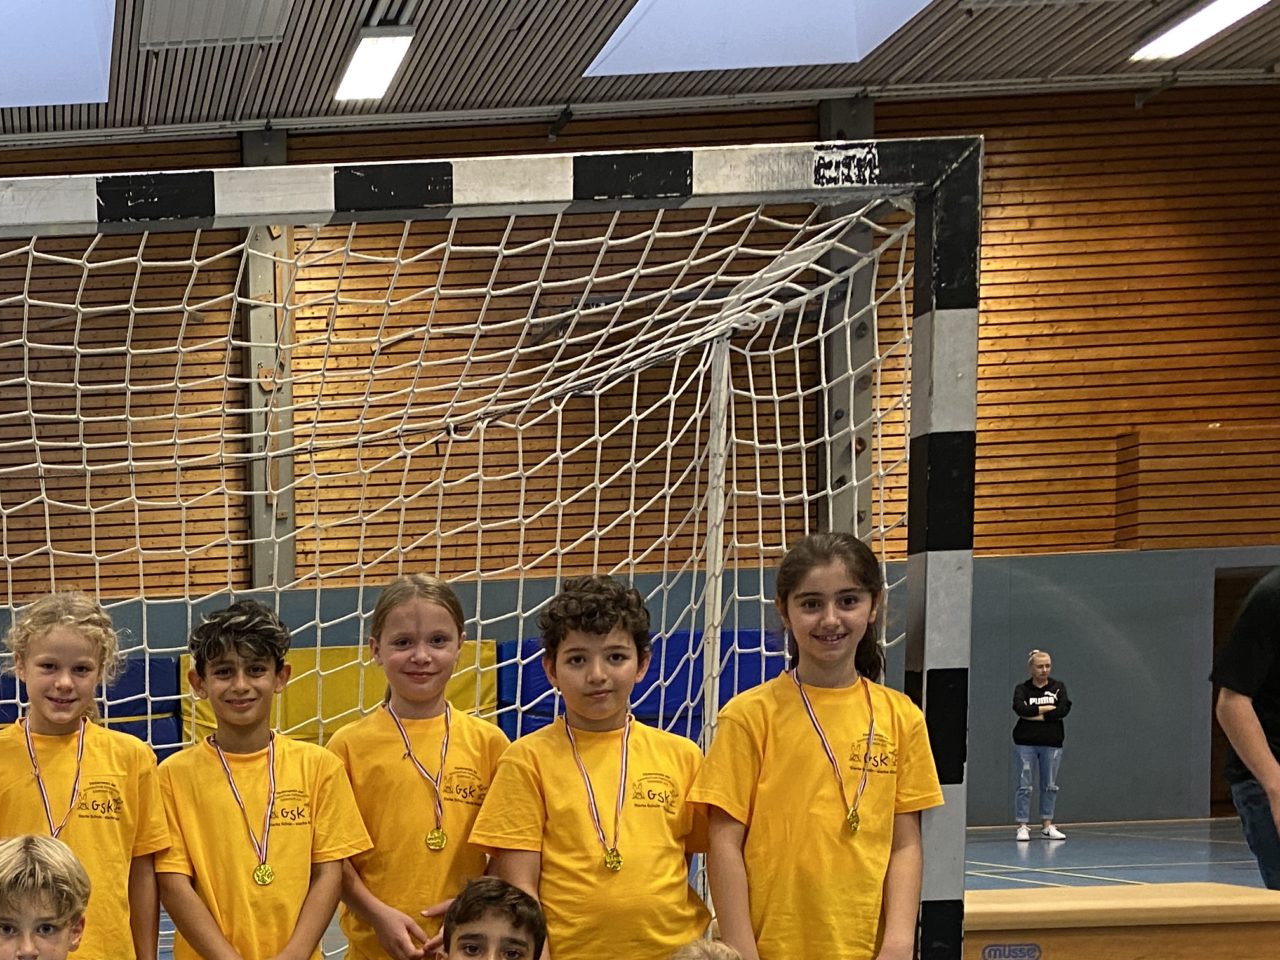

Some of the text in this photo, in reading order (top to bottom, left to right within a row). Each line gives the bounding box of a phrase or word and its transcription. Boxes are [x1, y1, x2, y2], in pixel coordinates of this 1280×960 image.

[1029, 696, 1055, 706] PUMA
[455, 784, 476, 799] GSK
[92, 799, 113, 815] GSK
[281, 806, 305, 819] GSK
